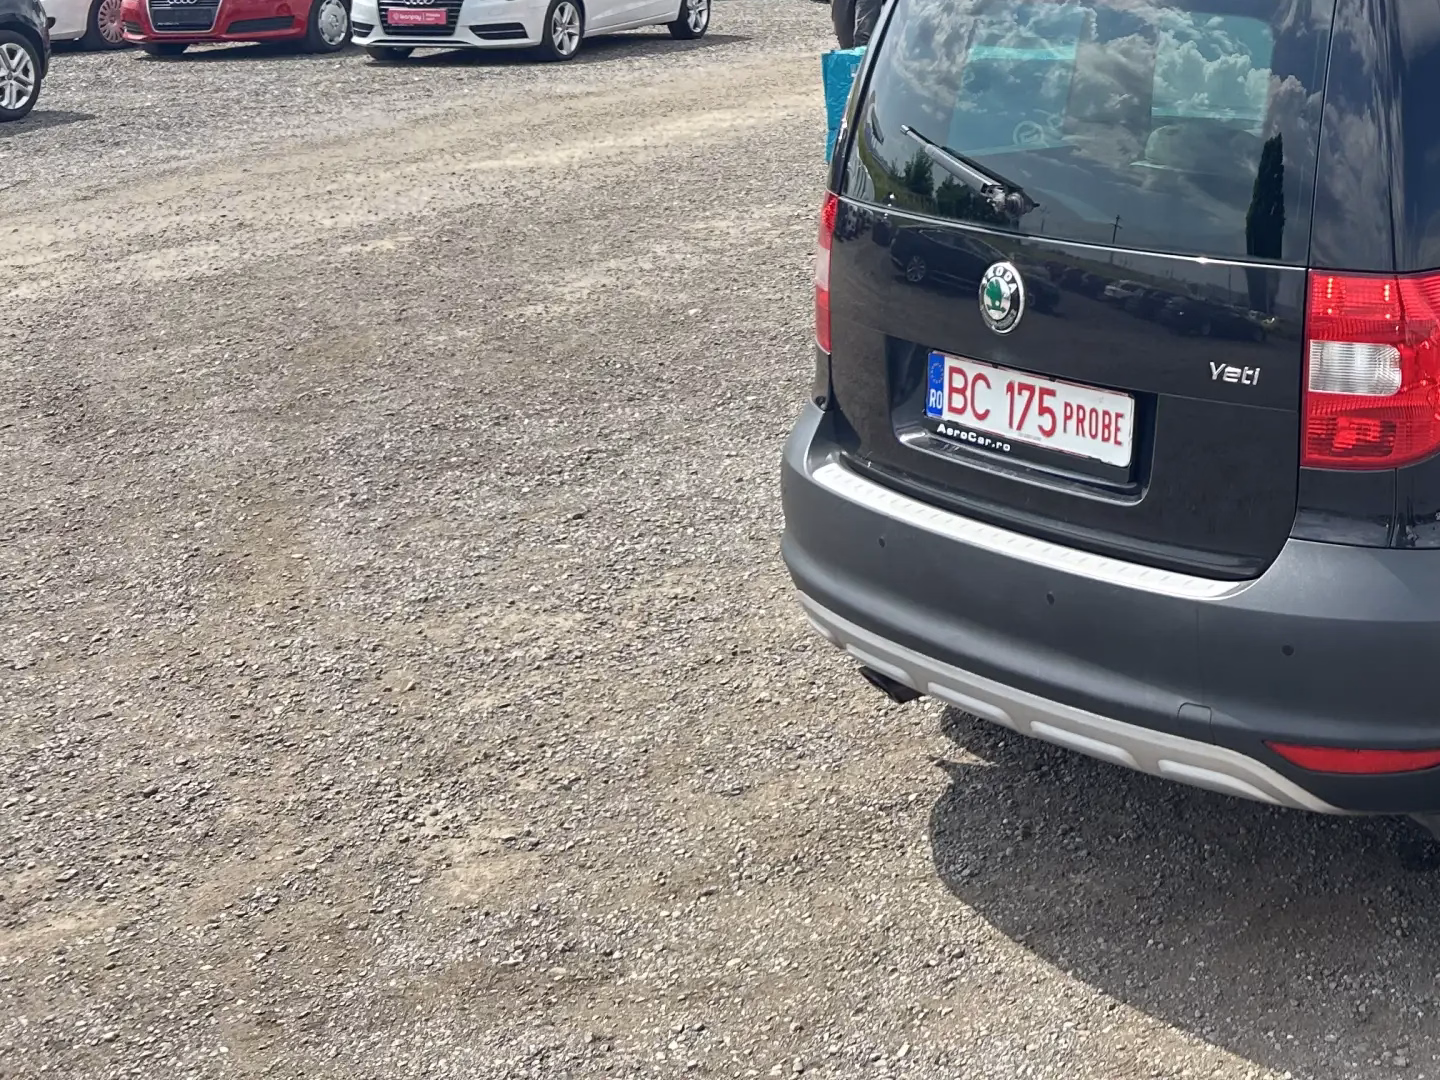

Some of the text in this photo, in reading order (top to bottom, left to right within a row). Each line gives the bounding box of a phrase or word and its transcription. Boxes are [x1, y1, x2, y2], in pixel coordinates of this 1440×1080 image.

[1209, 361, 1261, 386] Yeti
[929, 388, 943, 409] RO
[947, 365, 1124, 447] BC 175 PROBE
[936, 423, 1011, 452] AeroCar.ro
